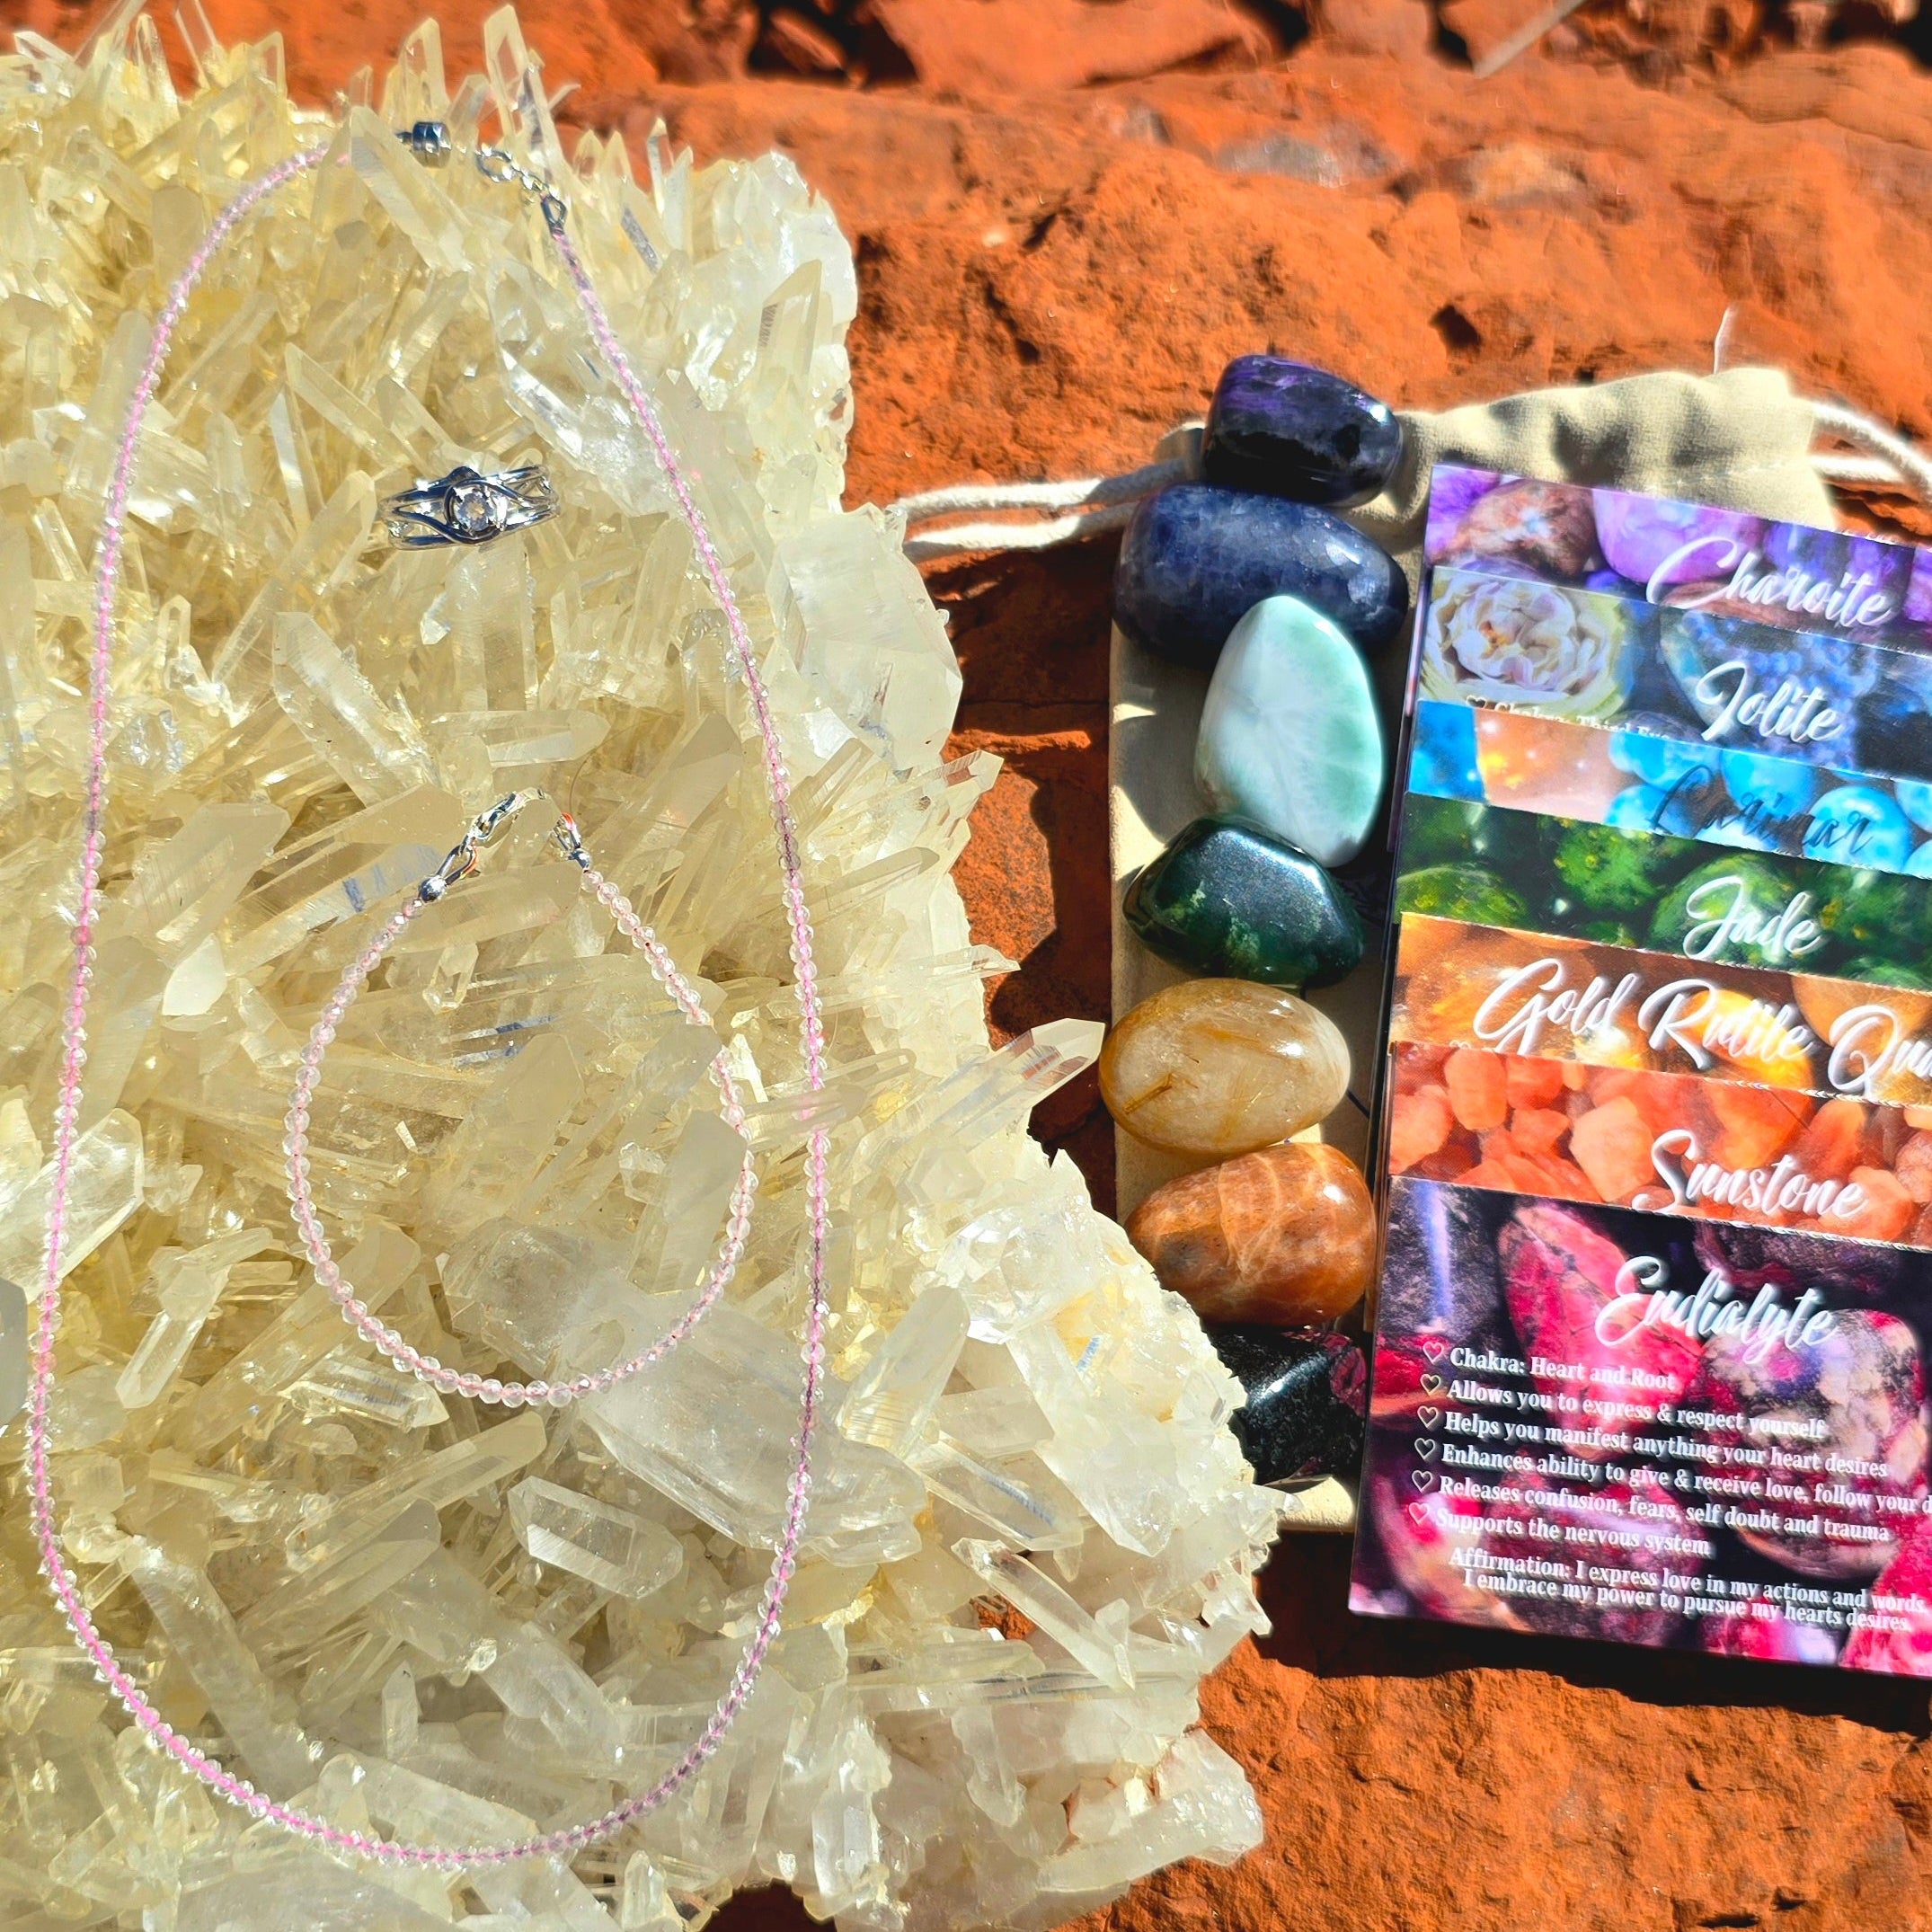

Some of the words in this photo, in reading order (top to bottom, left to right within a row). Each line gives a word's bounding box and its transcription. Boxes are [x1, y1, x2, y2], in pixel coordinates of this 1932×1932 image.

[1646, 536, 1892, 626] Charoite
[1683, 875, 1822, 960] Jade
[1473, 958, 1638, 1055] Gold
[1637, 979, 1813, 1069] Rutile
[1632, 1129, 1868, 1218] Sunstone
[1450, 1347, 1525, 1374] Chakra:
[1530, 1356, 1584, 1379] Heart
[1591, 1365, 1625, 1385] and
[1630, 1371, 1675, 1390] Root
[1447, 1379, 1511, 1405] Allows
[1517, 1393, 1552, 1411] you
[1558, 1395, 1579, 1411] to
[1583, 1399, 1652, 1422] express
[1657, 1403, 1671, 1422] &
[1678, 1409, 1743, 1431] respect
[1749, 1417, 1827, 1439] yourself
[1444, 1411, 1498, 1439] Helps
[1504, 1422, 1539, 1441] you
[1546, 1427, 1628, 1449] manifest
[1634, 1436, 1718, 1463] anything
[1723, 1446, 1767, 1466] your
[1770, 1446, 1821, 1470] heart
[1825, 1453, 1887, 1477] desires
[1439, 1475, 1520, 1502] Releases
[1525, 1488, 1623, 1516] confusion,
[1629, 1495, 1681, 1522] fears,
[1686, 1503, 1722, 1524] self
[1724, 1506, 1778, 1528] doubt
[1784, 1515, 1818, 1535] and
[1823, 1520, 1889, 1542] trauma
[1442, 1443, 1537, 1471] Enhances
[1538, 1454, 1600, 1482] ability
[1605, 1463, 1625, 1481] to
[1629, 1466, 1669, 1487] give
[1674, 1469, 1690, 1489] &
[1695, 1476, 1761, 1496] receive
[1765, 1478, 1808, 1502] love,
[1813, 1483, 1873, 1509] follow
[1875, 1495, 1919, 1513] your
[1438, 1508, 1522, 1535] Supports
[1528, 1517, 1560, 1538] the
[1564, 1527, 1639, 1548] nervous
[1644, 1534, 1709, 1555] system
[1449, 1546, 1570, 1577] Affirmation:
[1574, 1560, 1584, 1579] I
[1589, 1564, 1657, 1587] express
[1662, 1567, 1701, 1591] love
[1706, 1574, 1725, 1593] in
[1730, 1580, 1759, 1600] my
[1763, 1582, 1828, 1604] actions
[1832, 1589, 1866, 1607] and
[1463, 1568, 1474, 1588] I
[1477, 1572, 1556, 1595] embrace
[1563, 1583, 1592, 1601] my
[1597, 1585, 1653, 1607] power
[1660, 1591, 1678, 1609] to
[1683, 1594, 1747, 1614] pursue
[1751, 1602, 1781, 1621] my
[1784, 1600, 1842, 1625] hearts
